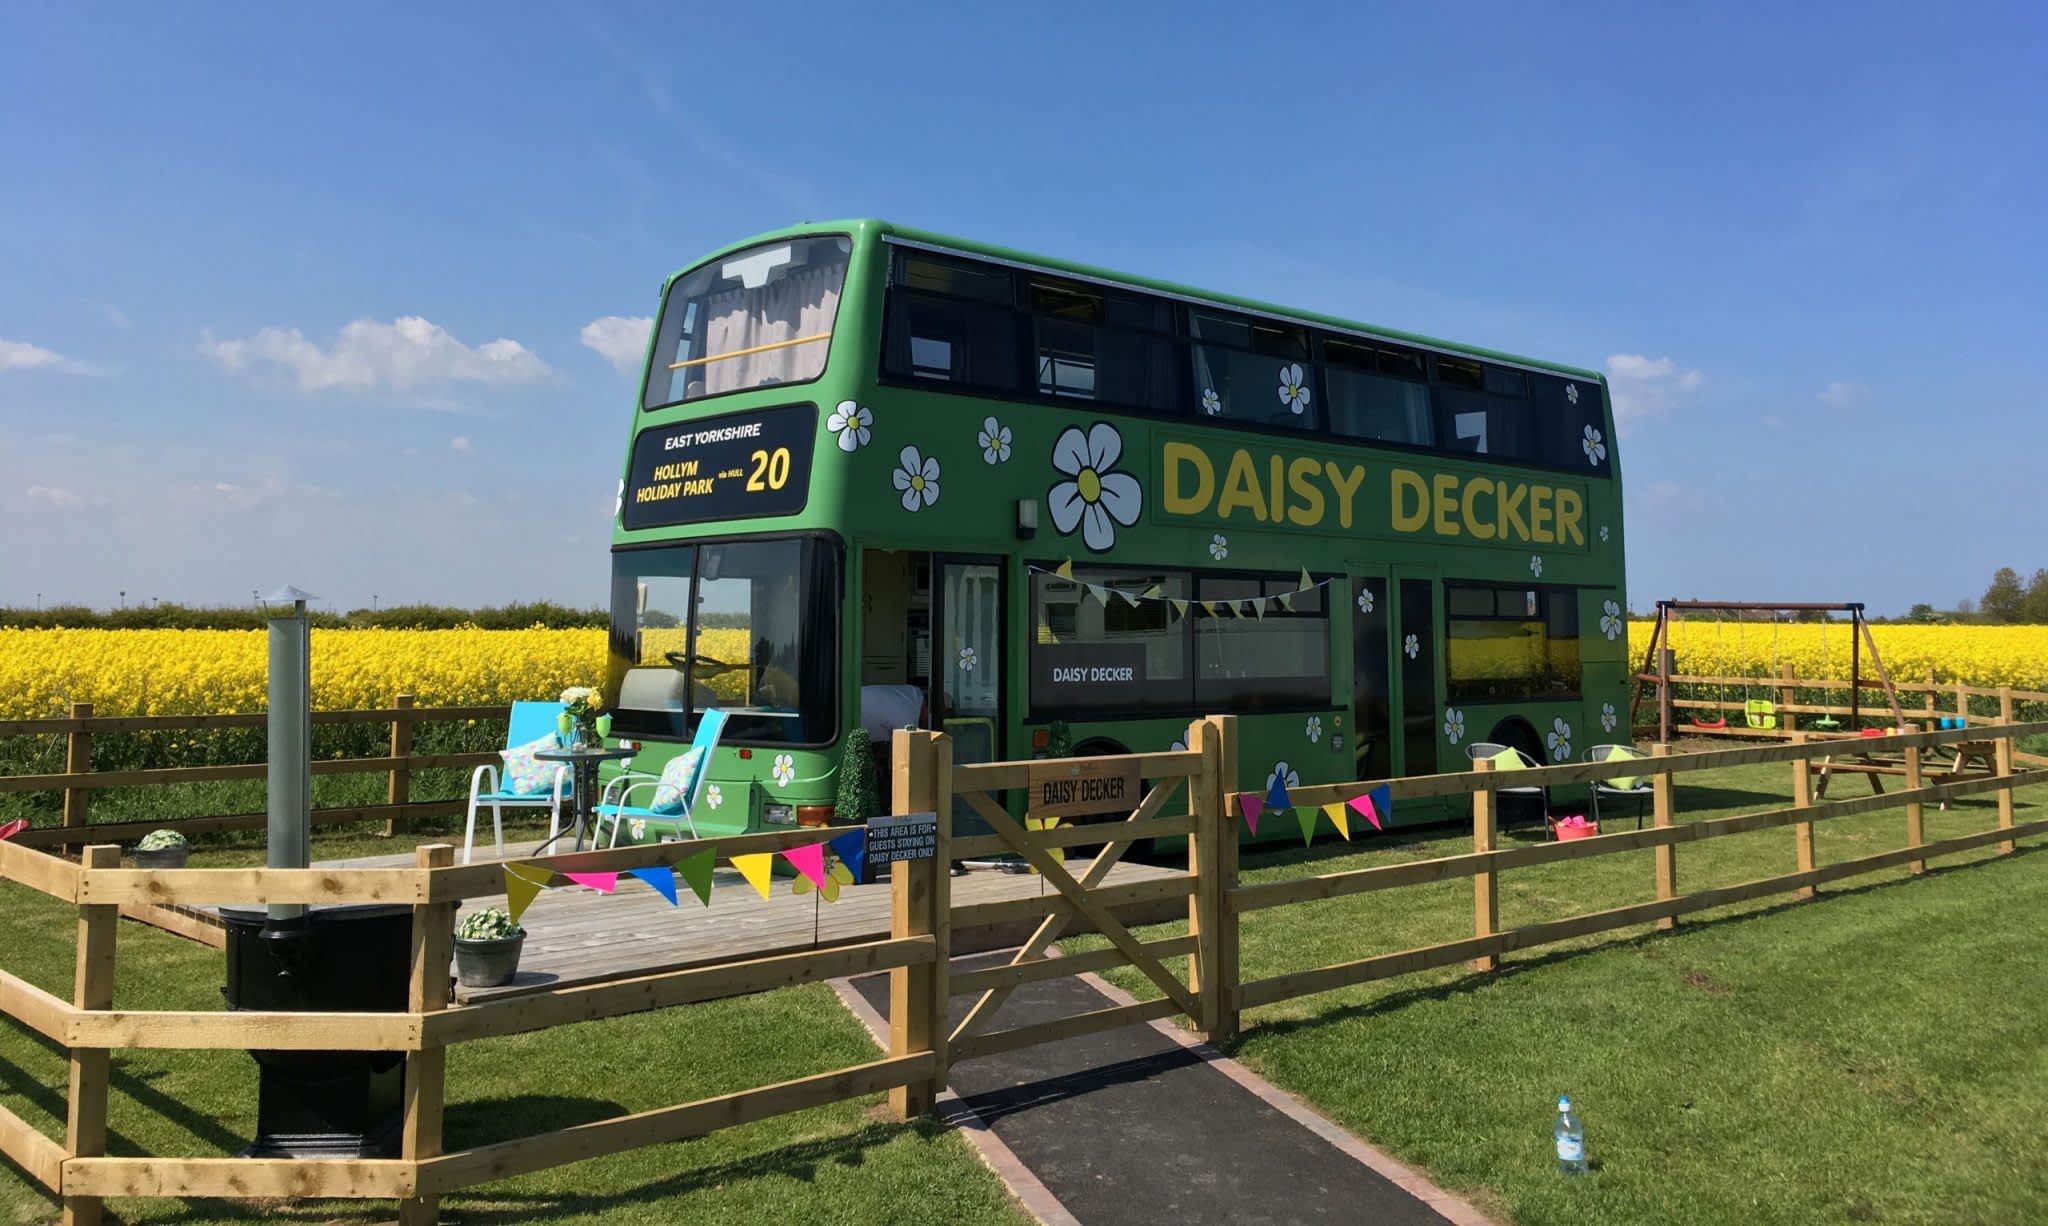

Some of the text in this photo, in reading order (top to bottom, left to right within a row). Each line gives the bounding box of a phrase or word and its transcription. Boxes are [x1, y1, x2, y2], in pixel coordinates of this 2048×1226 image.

[664, 423, 762, 450] EAST YORKSHIRE
[654, 460, 699, 481] HOLLYM
[727, 468, 744, 478] HULL
[746, 447, 790, 492] 20
[636, 478, 714, 503] HOLIDAY PARK
[1163, 441, 1585, 546] DAISY DECKER
[1053, 667, 1133, 682] DAISY DECKER
[1043, 777, 1125, 805] DAISY DECKER
[873, 824, 932, 839] THIS AREA IS FOR
[869, 835, 935, 851] GUESTS STAYING ON
[869, 847, 935, 864] DAISY DECKER ONLY
